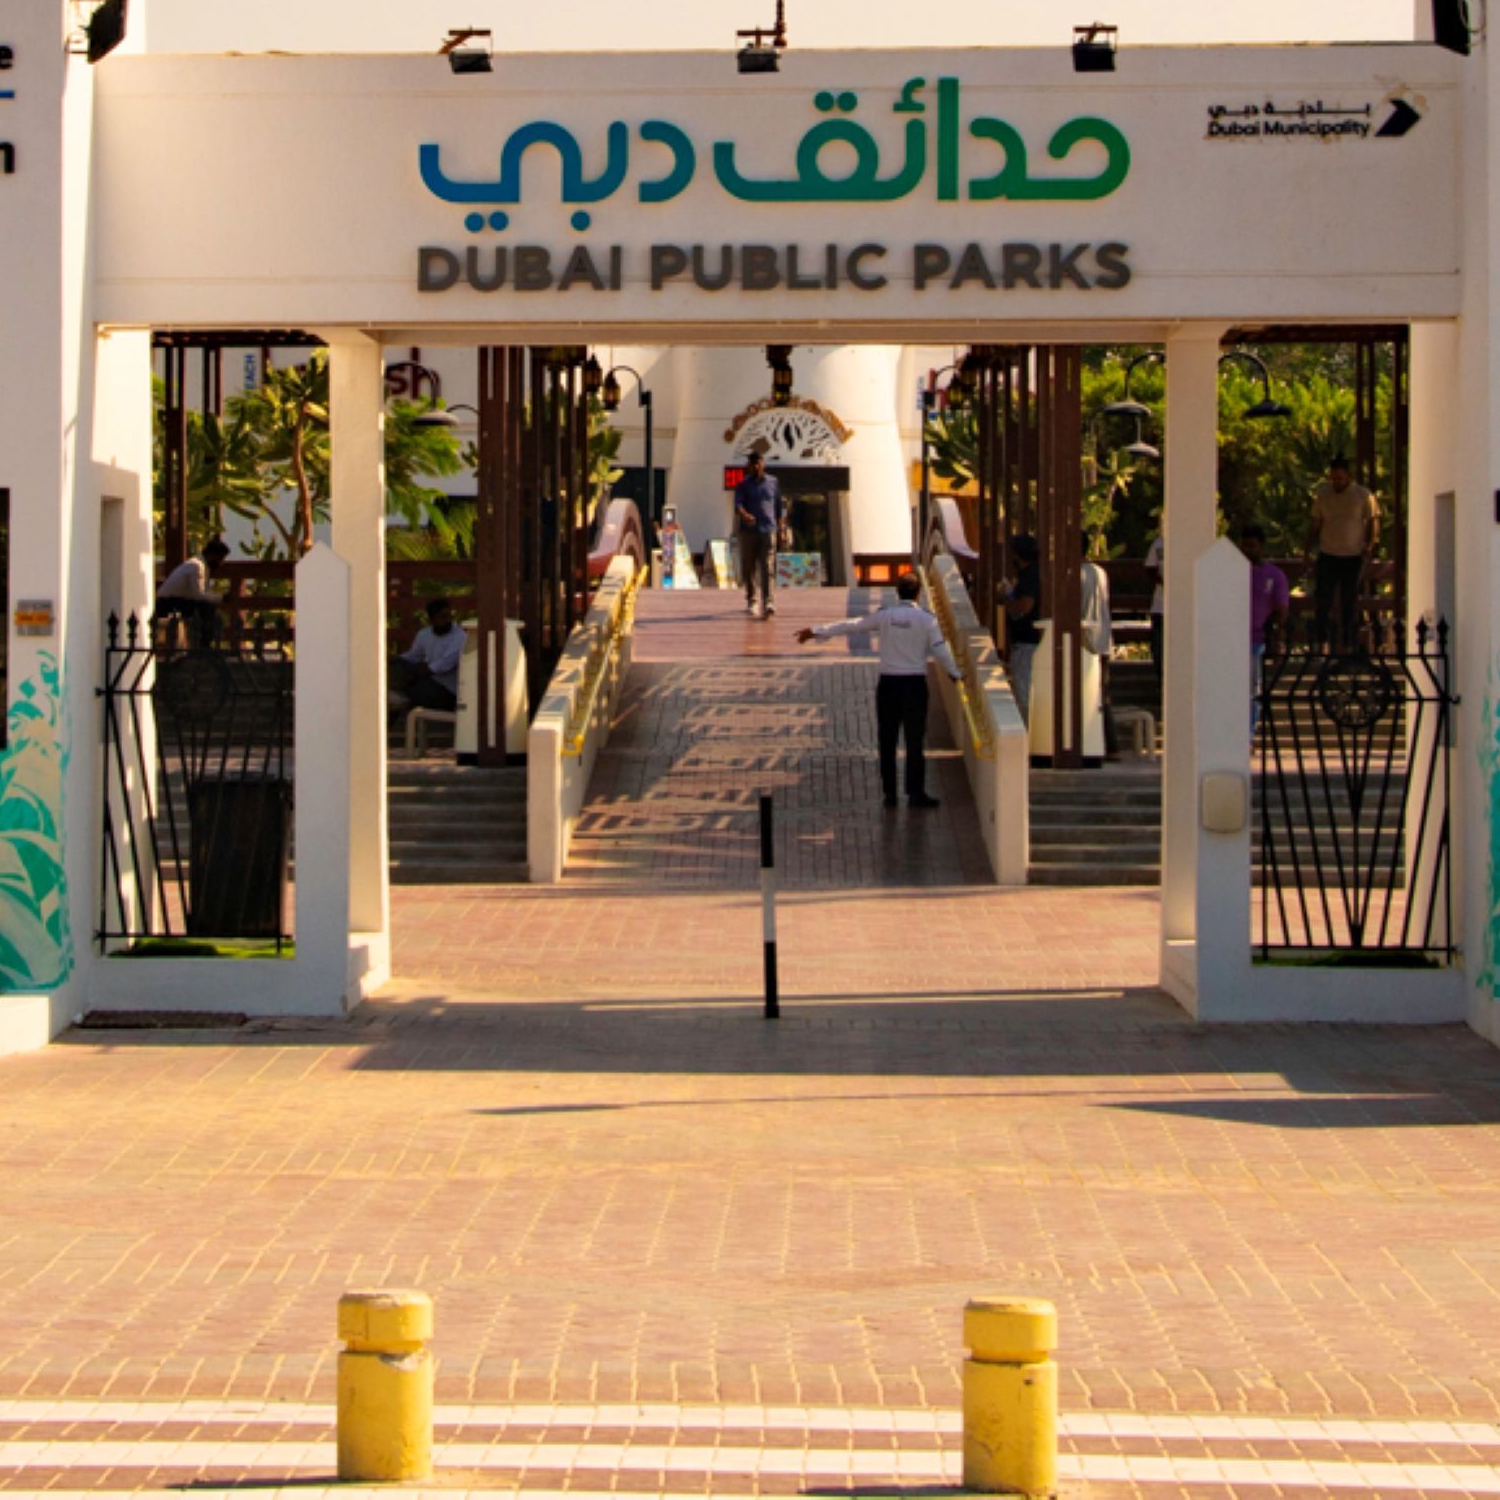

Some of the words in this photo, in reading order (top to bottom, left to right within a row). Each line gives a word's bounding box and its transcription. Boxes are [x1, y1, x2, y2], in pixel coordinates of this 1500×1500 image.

[715, 76, 1131, 202] حدائق
[1208, 120, 1260, 137] Dubai
[1263, 120, 1371, 139] Municipality
[419, 120, 695, 232] دبي
[418, 244, 624, 293] DUBAI
[648, 241, 889, 292] PUBLIC
[908, 240, 1135, 292] PARKS
